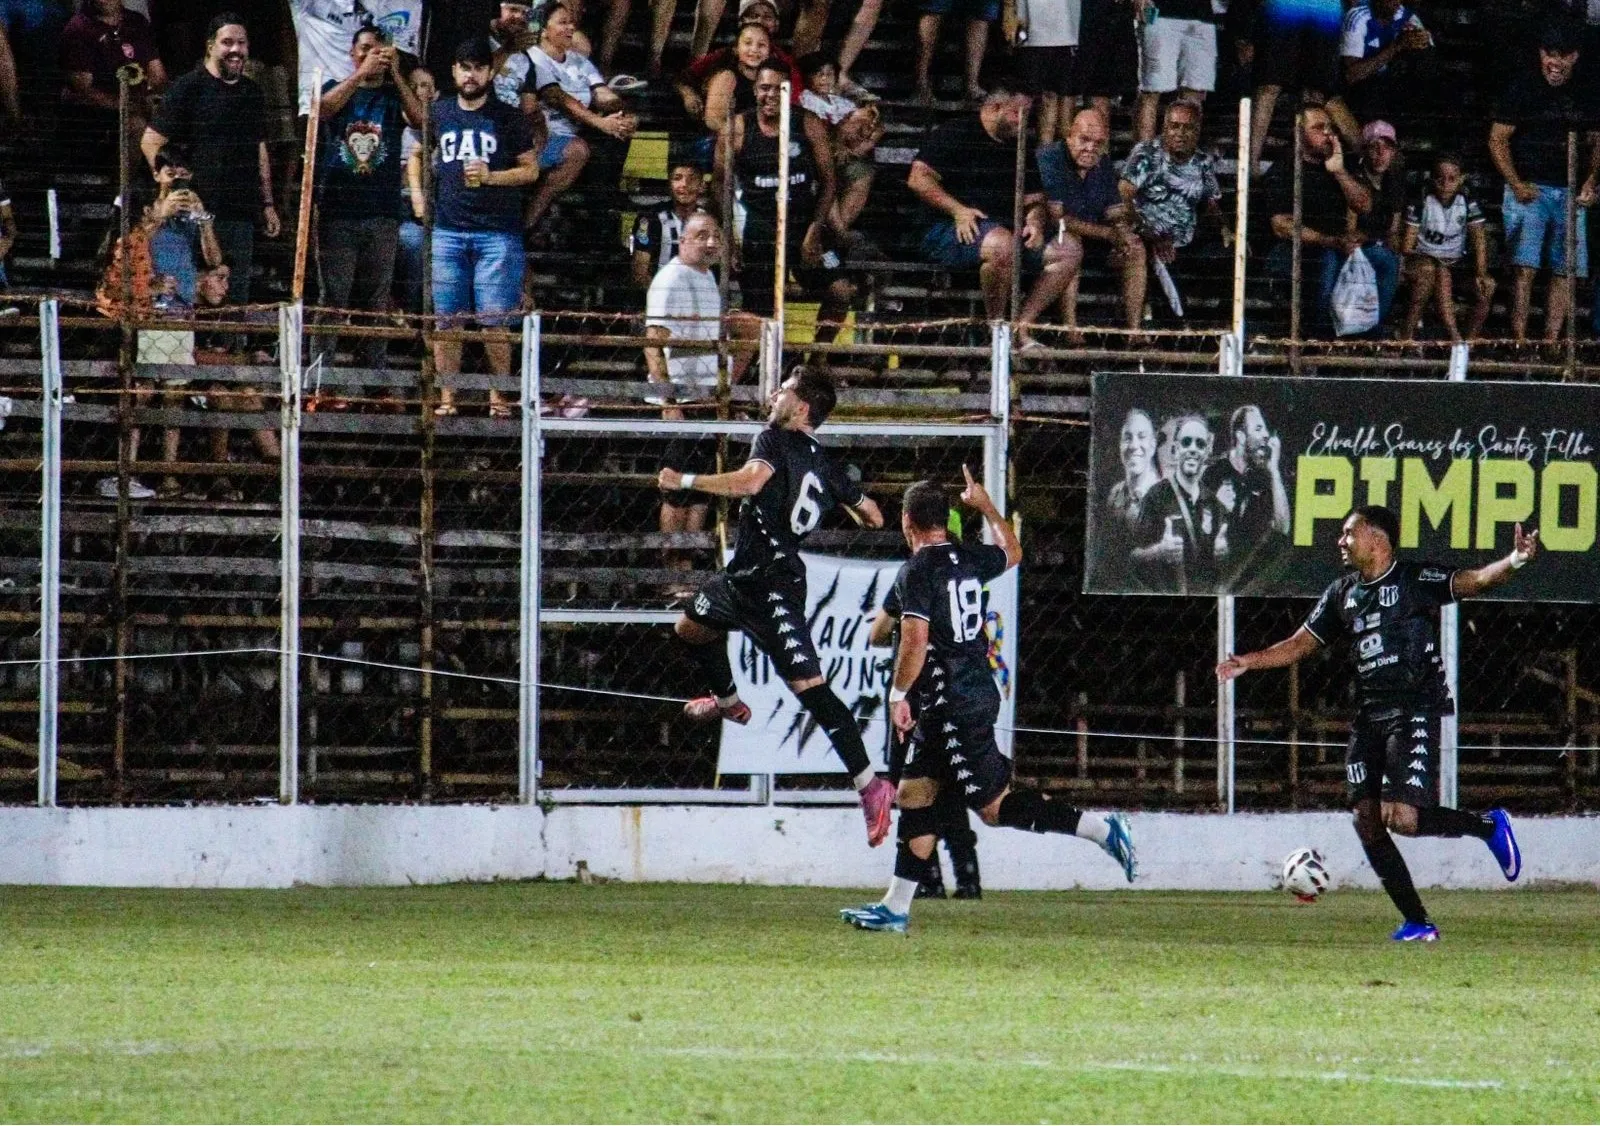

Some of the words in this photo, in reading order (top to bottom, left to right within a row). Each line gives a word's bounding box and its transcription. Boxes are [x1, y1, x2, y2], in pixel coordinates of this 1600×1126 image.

[440, 128, 497, 163] GAP
[1305, 421, 1381, 459] Edvaldo
[1383, 422, 1446, 461] Soares
[1448, 427, 1475, 461] dos
[1478, 424, 1538, 465] Santos
[1541, 428, 1595, 466] Filho
[790, 470, 823, 536] 6
[947, 577, 983, 643] 18
